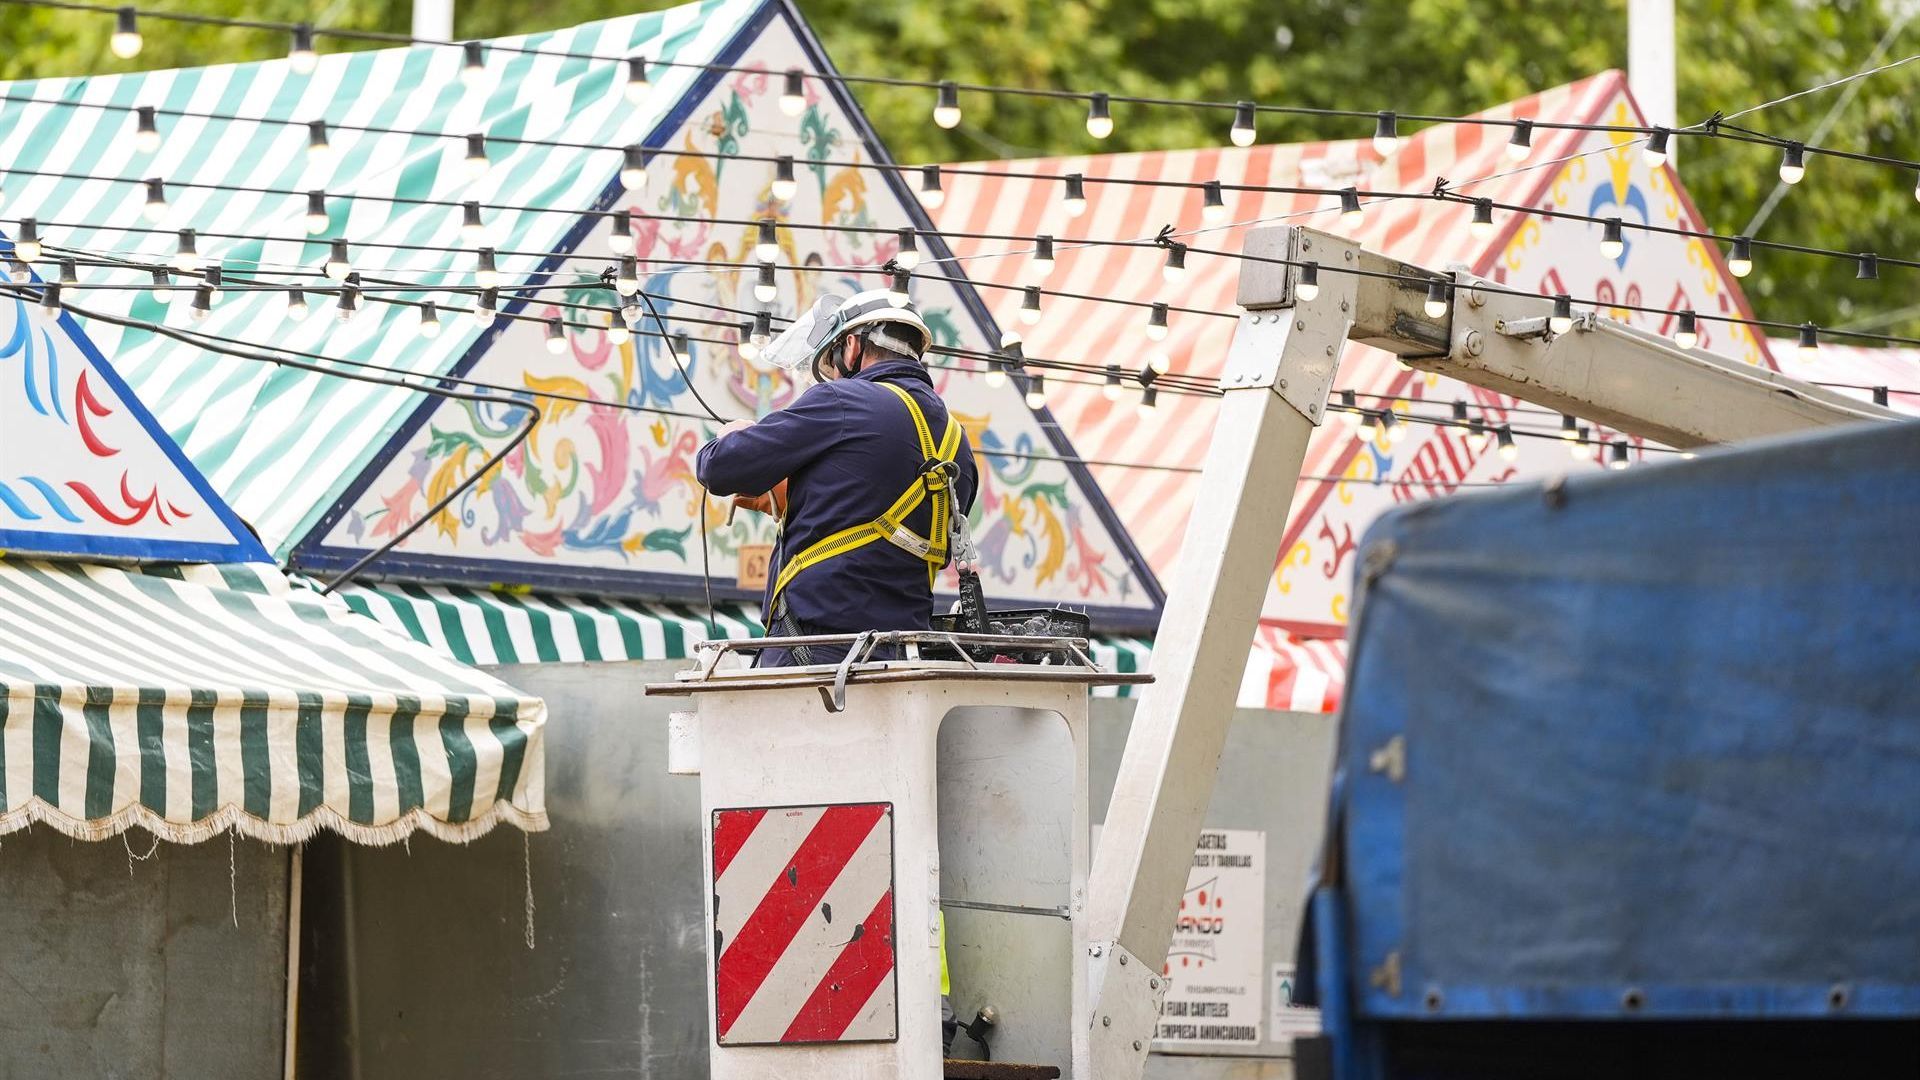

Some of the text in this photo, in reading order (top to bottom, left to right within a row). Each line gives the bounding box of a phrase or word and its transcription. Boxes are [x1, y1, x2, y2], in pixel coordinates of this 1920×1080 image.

[1196, 834, 1226, 850] ASETAS
[1175, 917, 1223, 934] NANDO
[1191, 1002, 1229, 1018] CARTELES
[1160, 1024, 1196, 1039] EMPRESA
